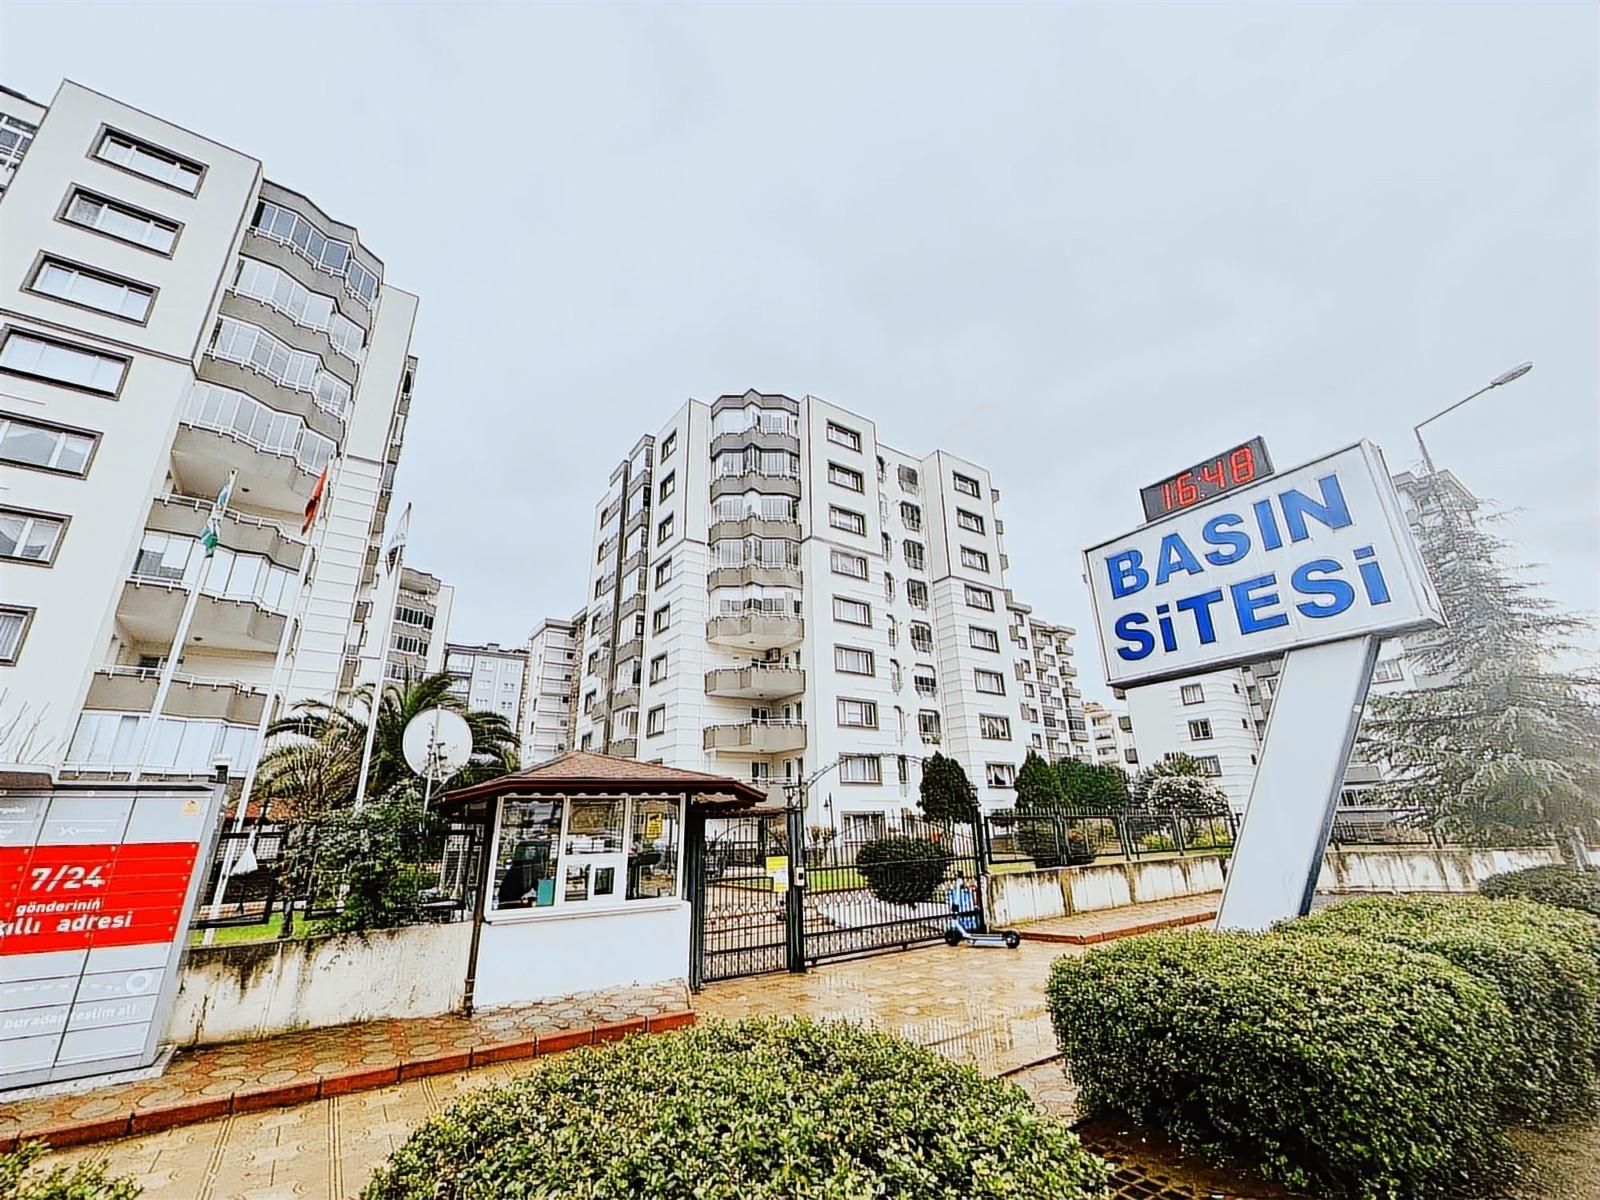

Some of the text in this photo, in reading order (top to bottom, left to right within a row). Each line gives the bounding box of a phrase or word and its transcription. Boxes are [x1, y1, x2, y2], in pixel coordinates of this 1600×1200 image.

[1163, 446, 1255, 511] 16:48
[1105, 474, 1353, 600] BASIN
[31, 864, 106, 892] 7/24
[56, 910, 134, 932] adresi
